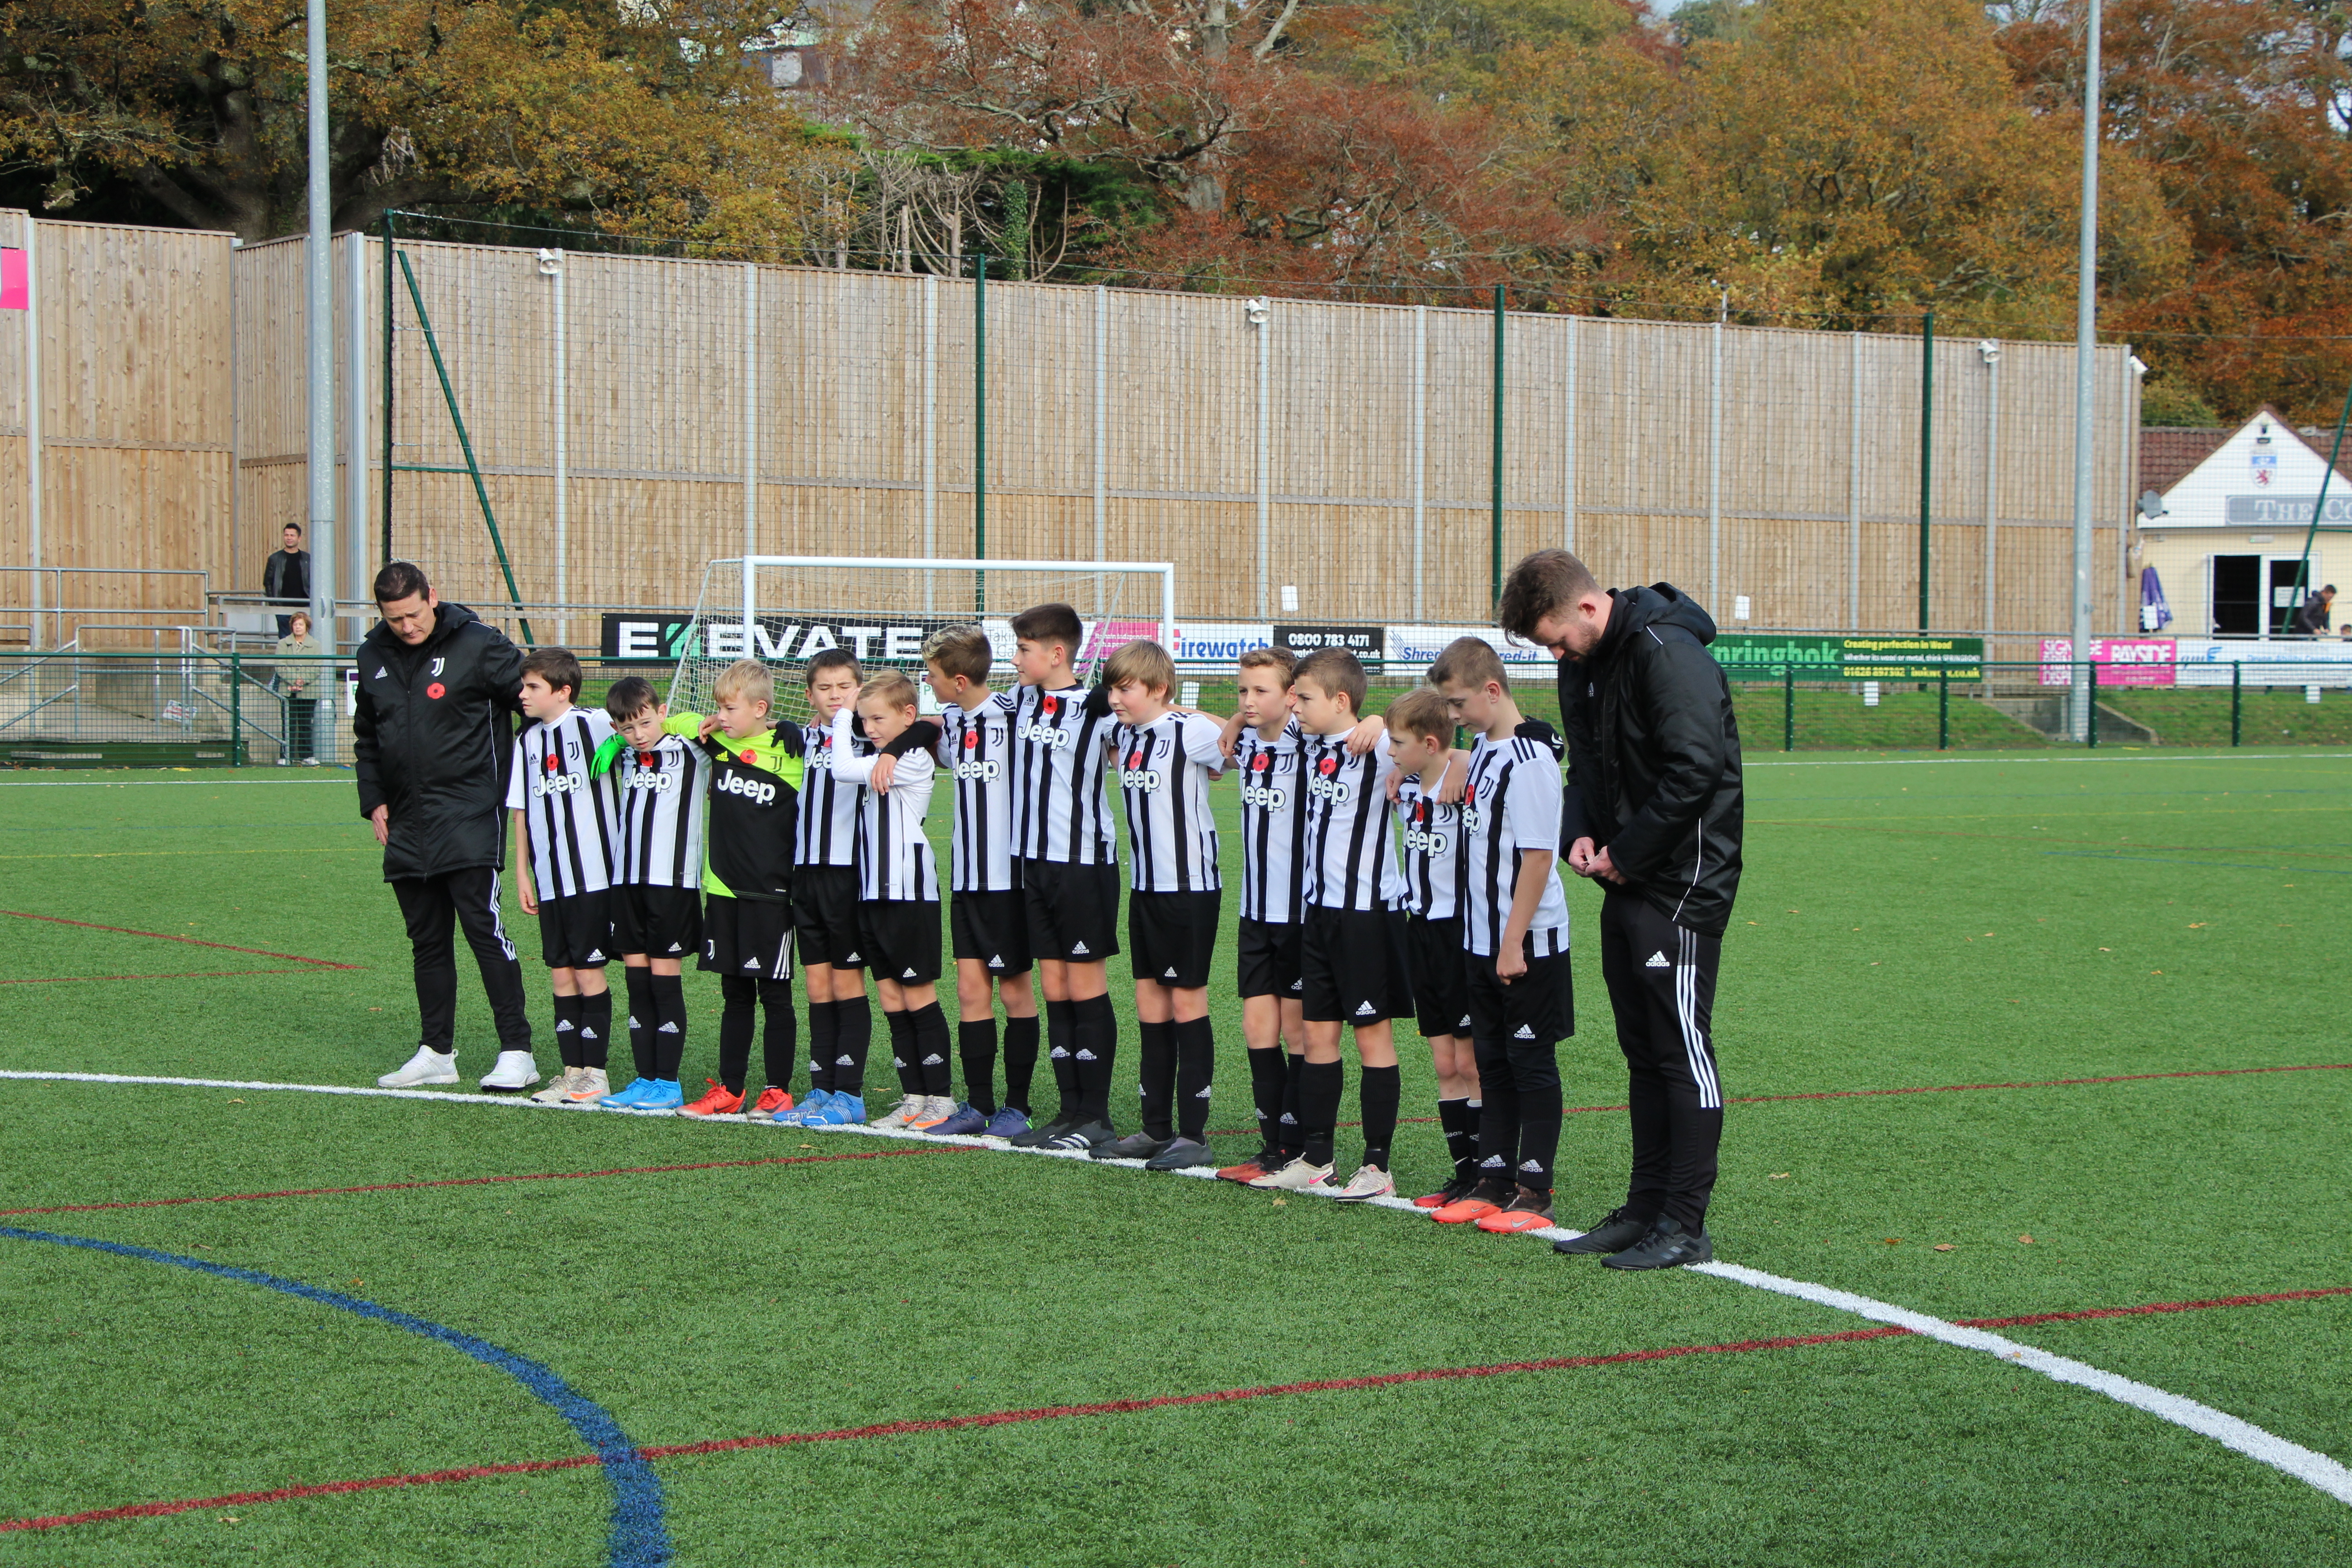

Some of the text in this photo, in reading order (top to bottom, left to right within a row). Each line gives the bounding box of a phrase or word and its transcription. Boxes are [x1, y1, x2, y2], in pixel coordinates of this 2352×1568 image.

[1288, 633, 1370, 647] 0800 783 4171
[1843, 640, 1877, 651] Creating
[1878, 640, 1920, 651] perfection
[1929, 641, 1952, 649] Wood
[1499, 650, 1538, 661] red-it
[1706, 639, 1839, 676] pringbok
[1018, 717, 1070, 750] Jeep
[805, 747, 833, 769] Jee
[953, 756, 1000, 783] Jeep
[533, 772, 583, 798] Jeep
[625, 767, 672, 794] Jeep
[717, 769, 776, 804] Jeep
[1119, 764, 1161, 794] Jeep
[1307, 767, 1350, 806] Jeep
[1240, 778, 1286, 813] Jeep
[1462, 805, 1481, 836] ep
